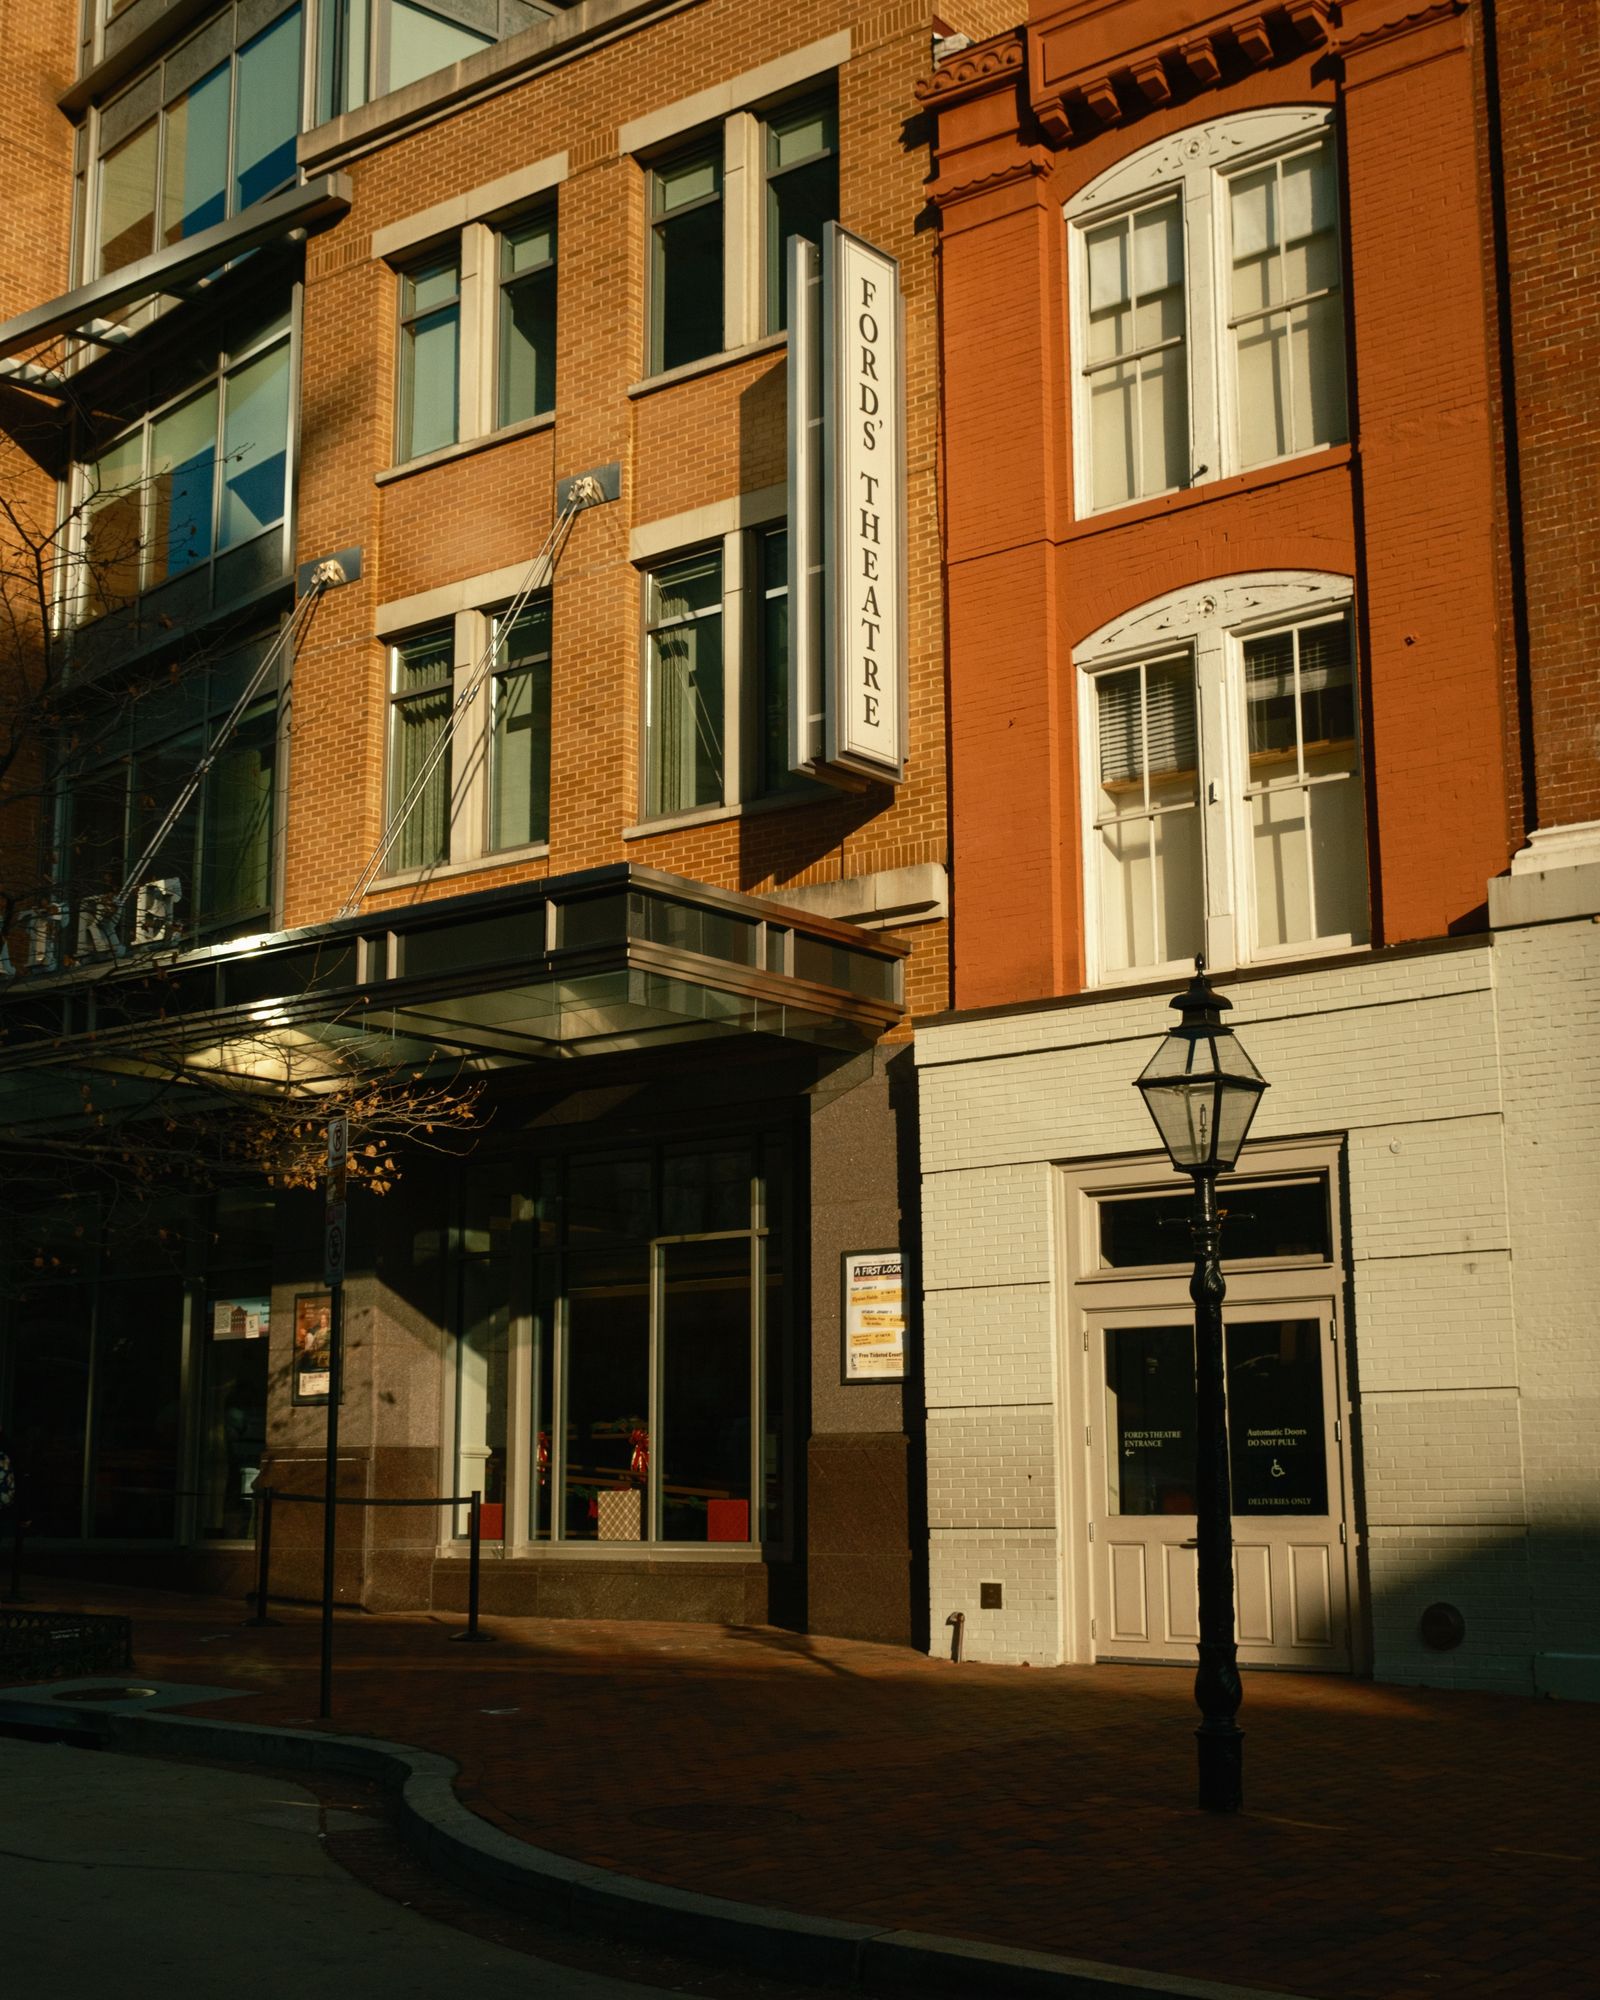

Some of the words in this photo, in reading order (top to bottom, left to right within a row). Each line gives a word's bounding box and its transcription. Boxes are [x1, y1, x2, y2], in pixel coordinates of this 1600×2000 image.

[860, 471, 882, 728] THEATRE
[855, 1267, 860, 1276] A
[862, 1266, 881, 1275] FIRST
[882, 1265, 902, 1274] LOOK
[1150, 1430, 1182, 1439] THEATRE
[1247, 1428, 1283, 1437] Automatic
[1284, 1427, 1307, 1436] Doors
[1124, 1440, 1163, 1448] ENTRANCE
[1247, 1439, 1259, 1447] DO
[1260, 1439, 1277, 1447] NOT
[1278, 1438, 1297, 1447] PULL
[1291, 1497, 1312, 1505] ONLY
